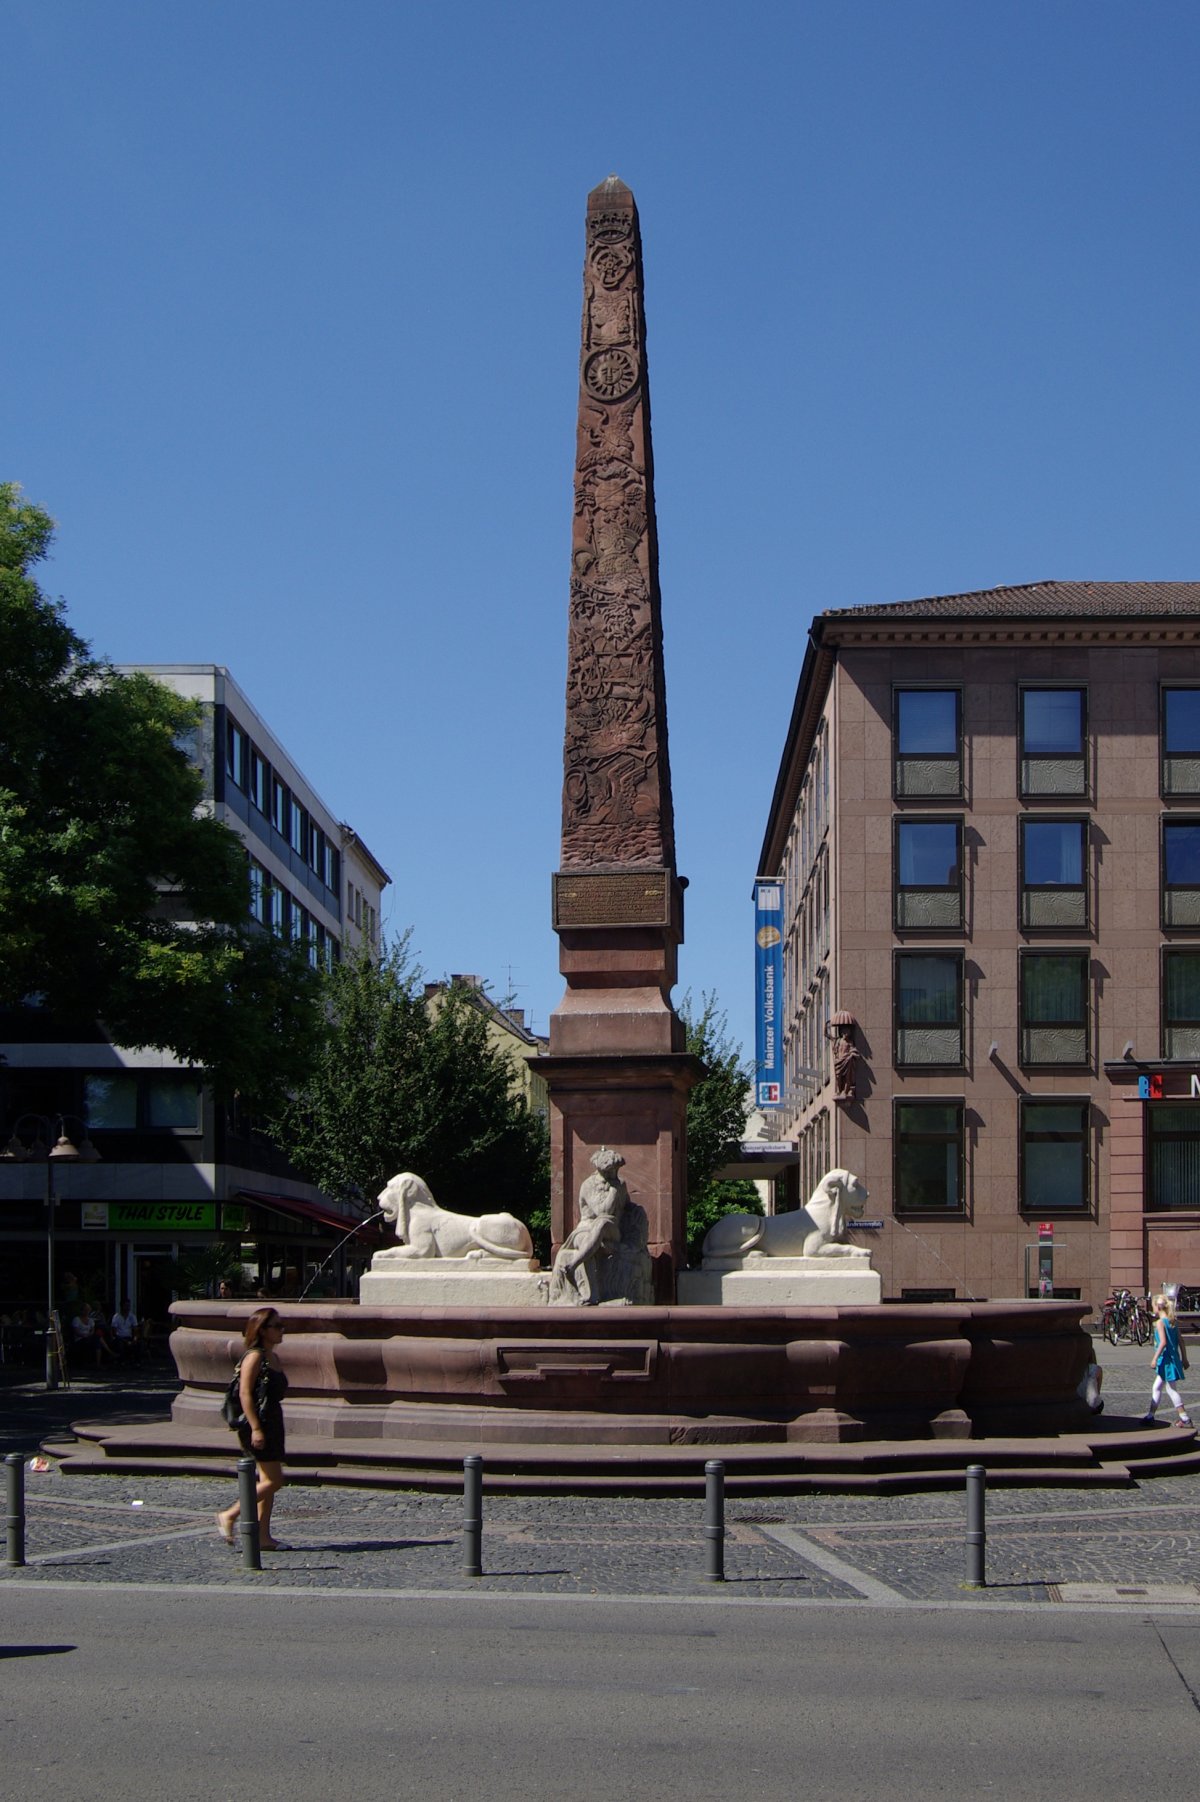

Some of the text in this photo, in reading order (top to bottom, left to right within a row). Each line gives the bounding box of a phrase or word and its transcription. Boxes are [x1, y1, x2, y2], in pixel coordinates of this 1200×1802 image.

[764, 964, 774, 1070] Mainzer Volksbank
[118, 1205, 205, 1221] THAI STYLE
